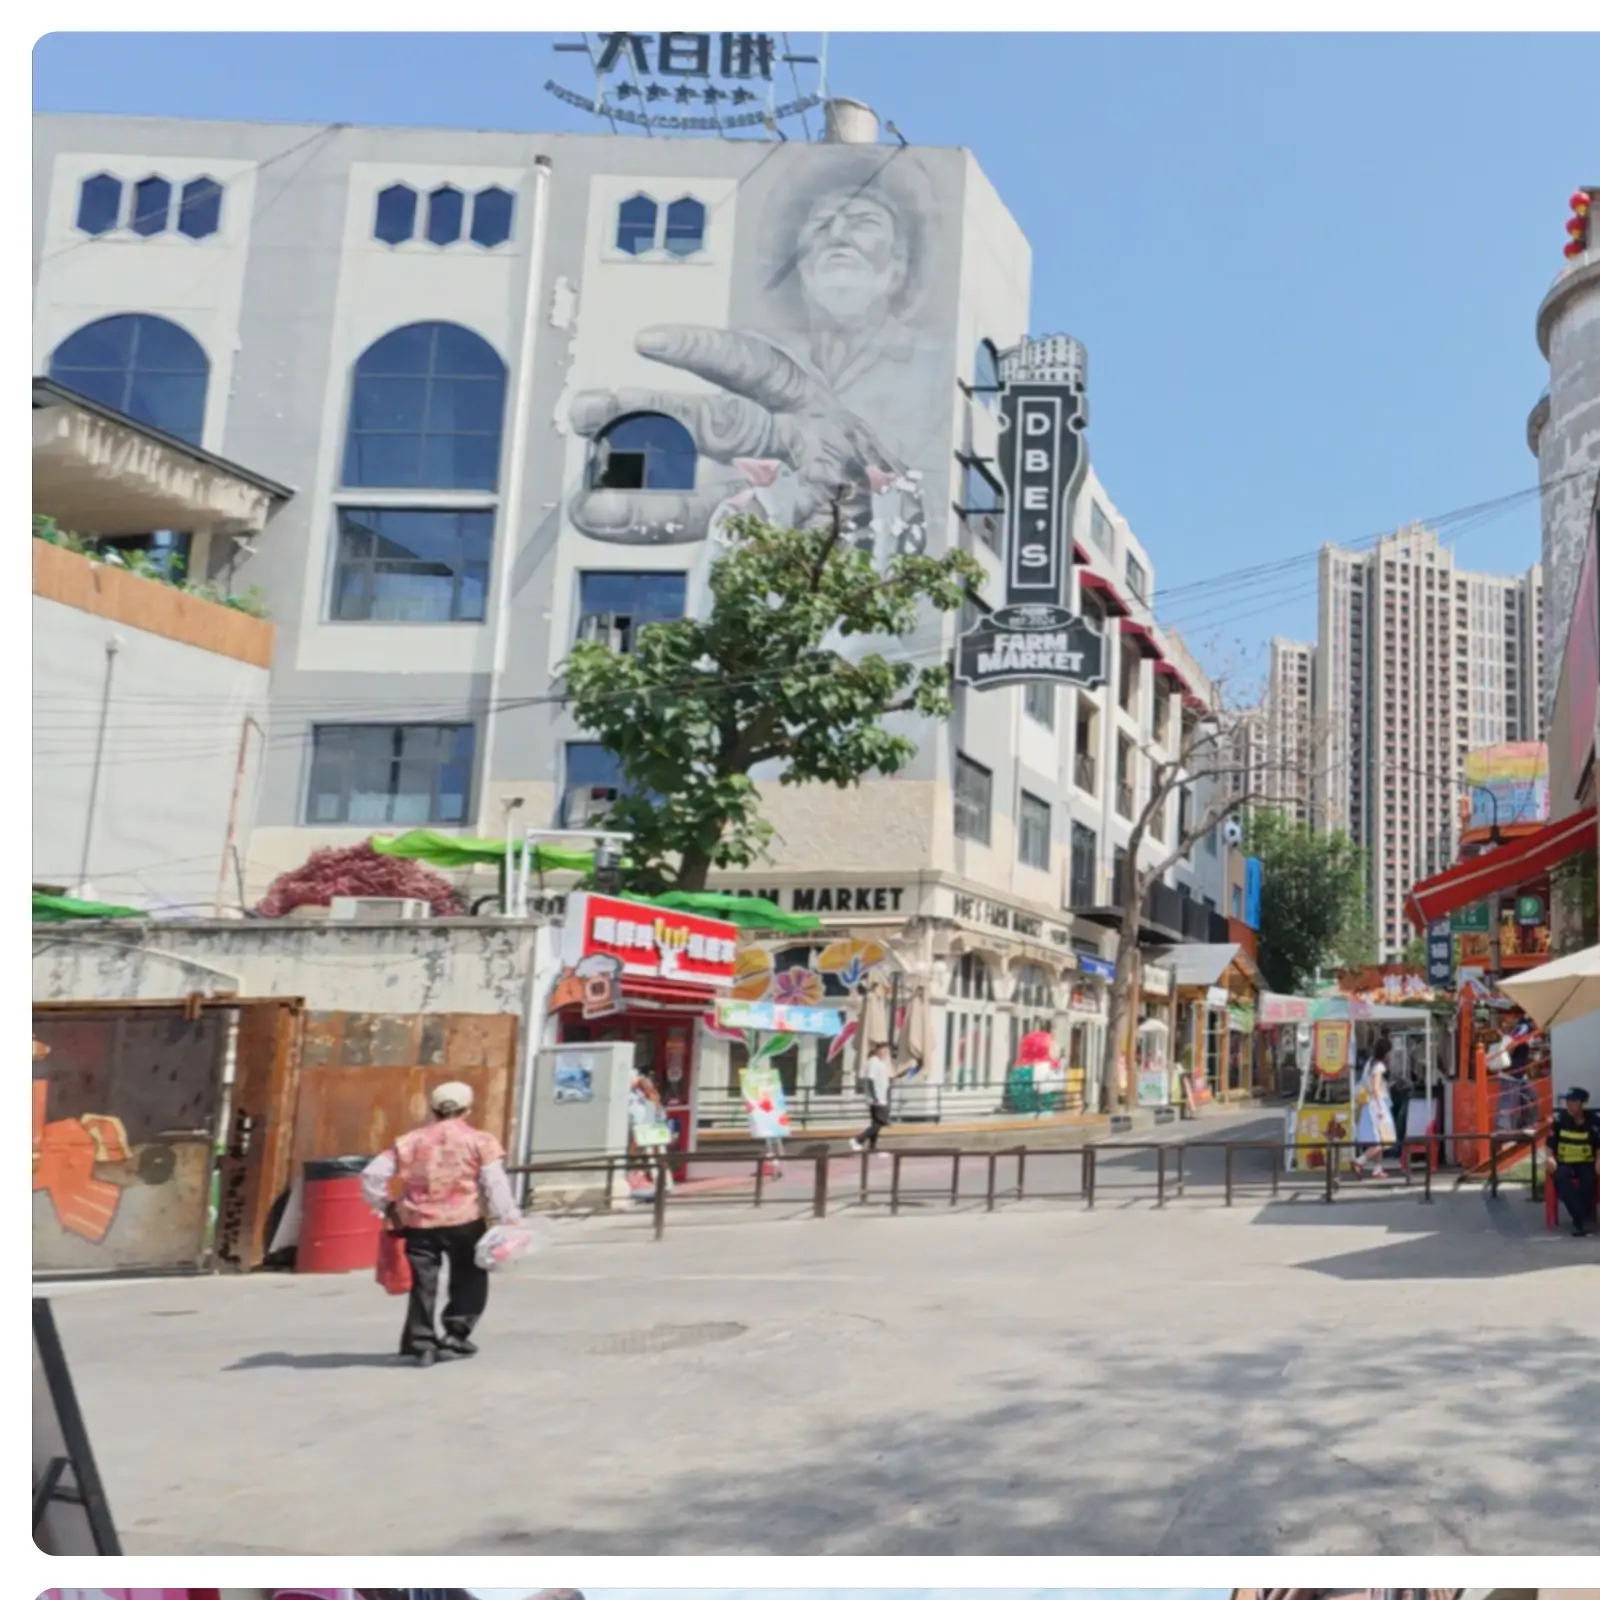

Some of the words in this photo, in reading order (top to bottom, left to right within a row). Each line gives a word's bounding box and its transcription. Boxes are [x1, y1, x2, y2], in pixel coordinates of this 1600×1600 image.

[994, 632, 1069, 651] FARM
[977, 651, 1085, 674] MARKET
[793, 887, 904, 911] MARKET
